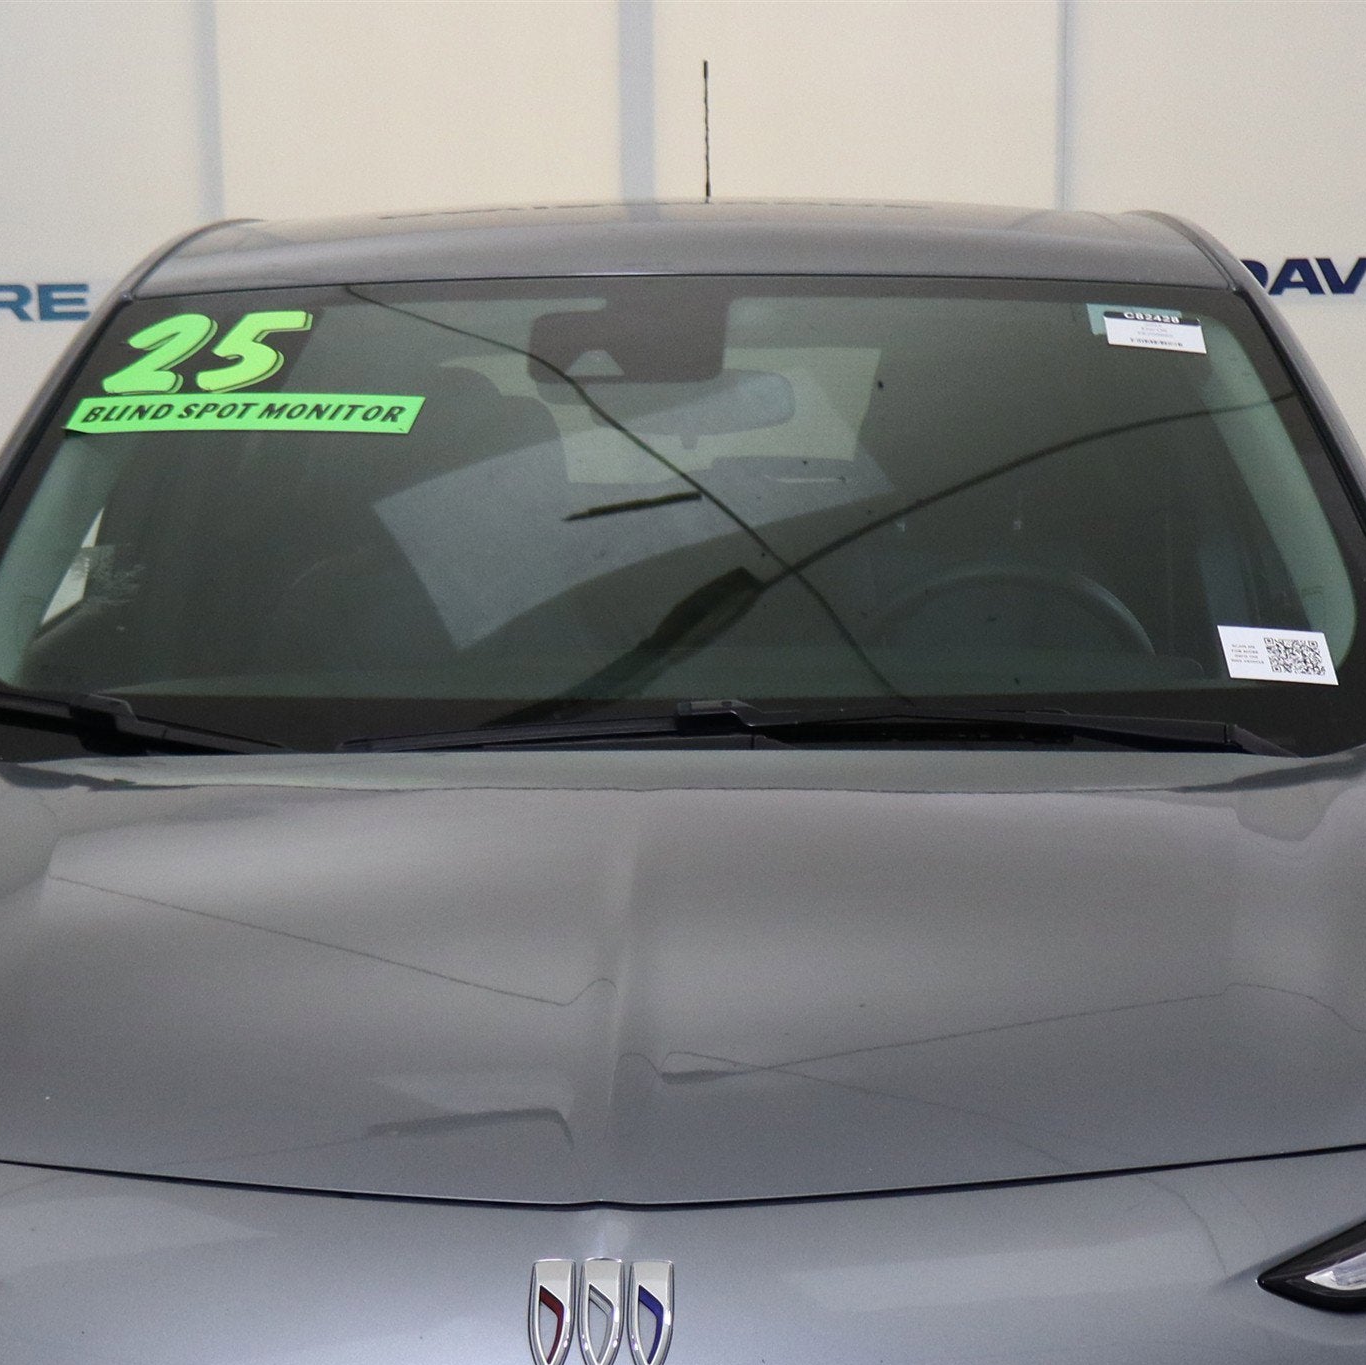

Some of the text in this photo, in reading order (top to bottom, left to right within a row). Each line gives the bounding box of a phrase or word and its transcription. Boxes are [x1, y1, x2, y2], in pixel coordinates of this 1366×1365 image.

[101, 310, 314, 395] 25
[81, 402, 407, 423] BLIND SPOT MONITOR
